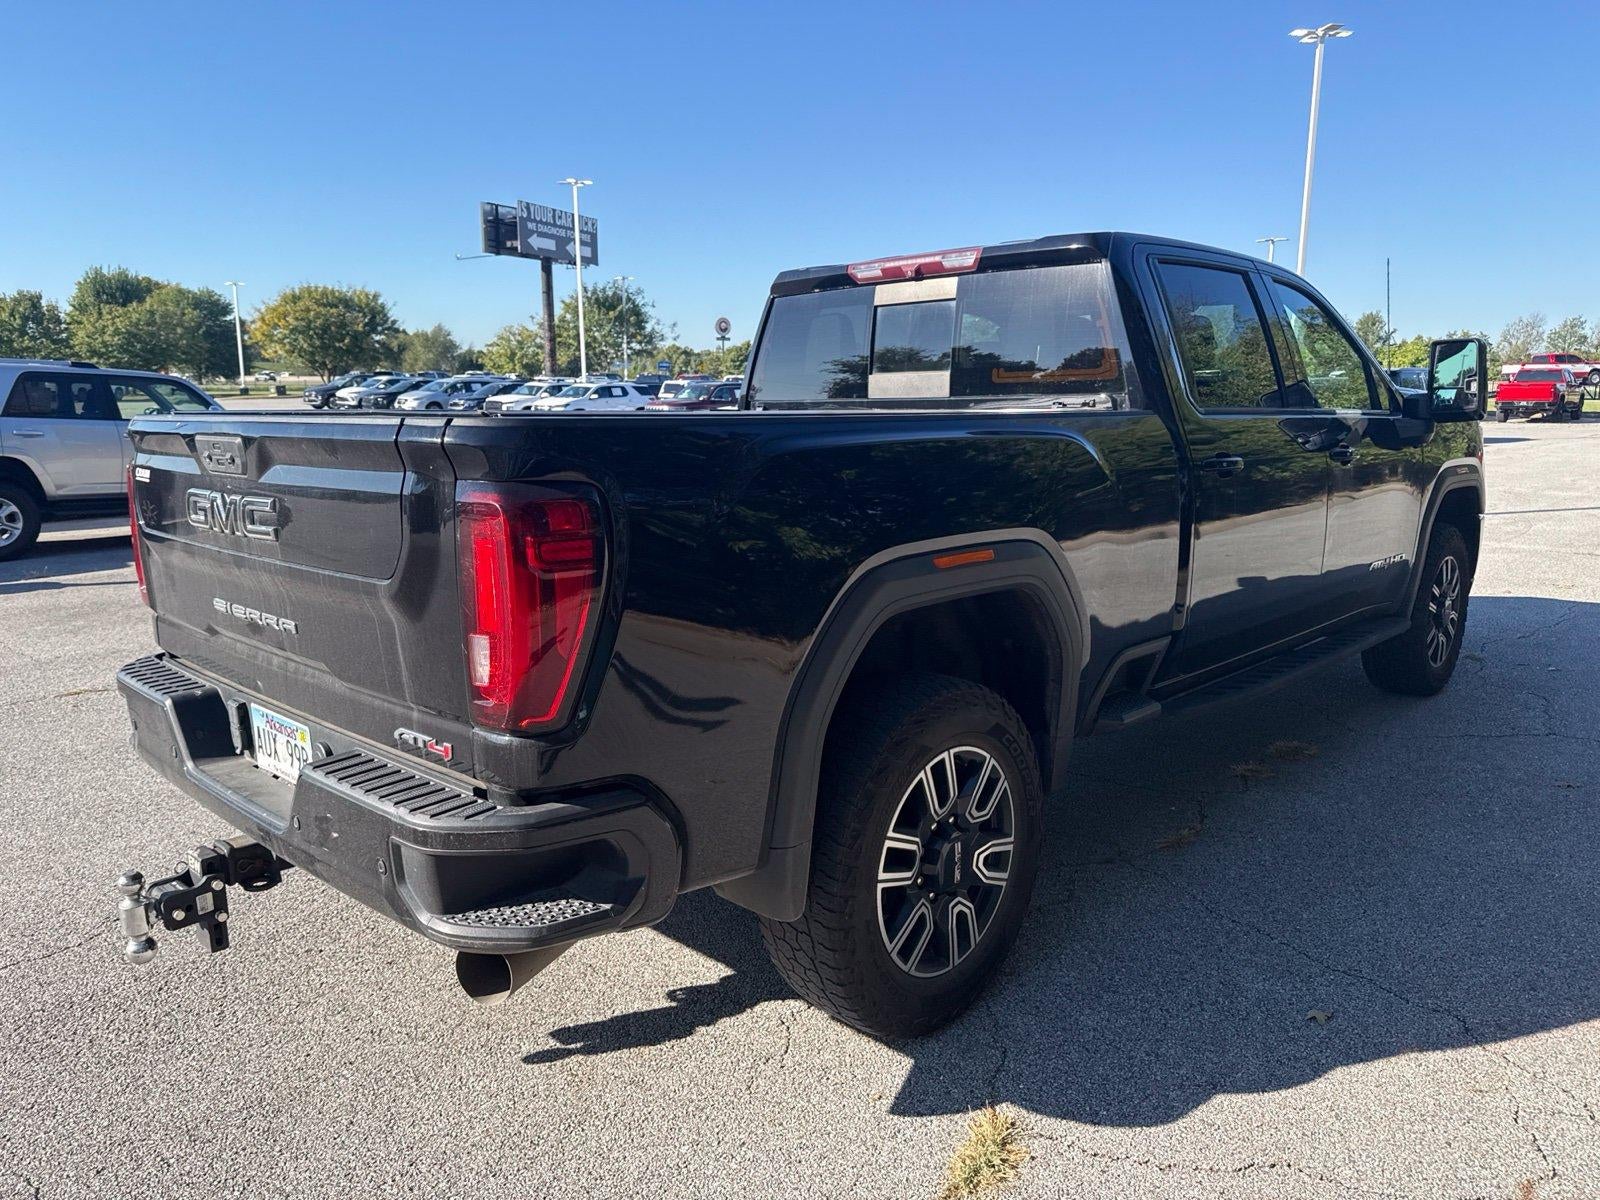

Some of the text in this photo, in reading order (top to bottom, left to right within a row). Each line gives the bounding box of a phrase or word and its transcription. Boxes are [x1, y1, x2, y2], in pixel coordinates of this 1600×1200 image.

[518, 202, 597, 233] IS YOUR CAR ICK?
[527, 221, 537, 231] WE
[537, 223, 566, 237] DIAGNOSE
[186, 488, 281, 542] GMC
[213, 598, 298, 634] SIERRA
[256, 726, 281, 762] AUX
[265, 713, 298, 741] Arkansas
[394, 728, 454, 762] AT4
